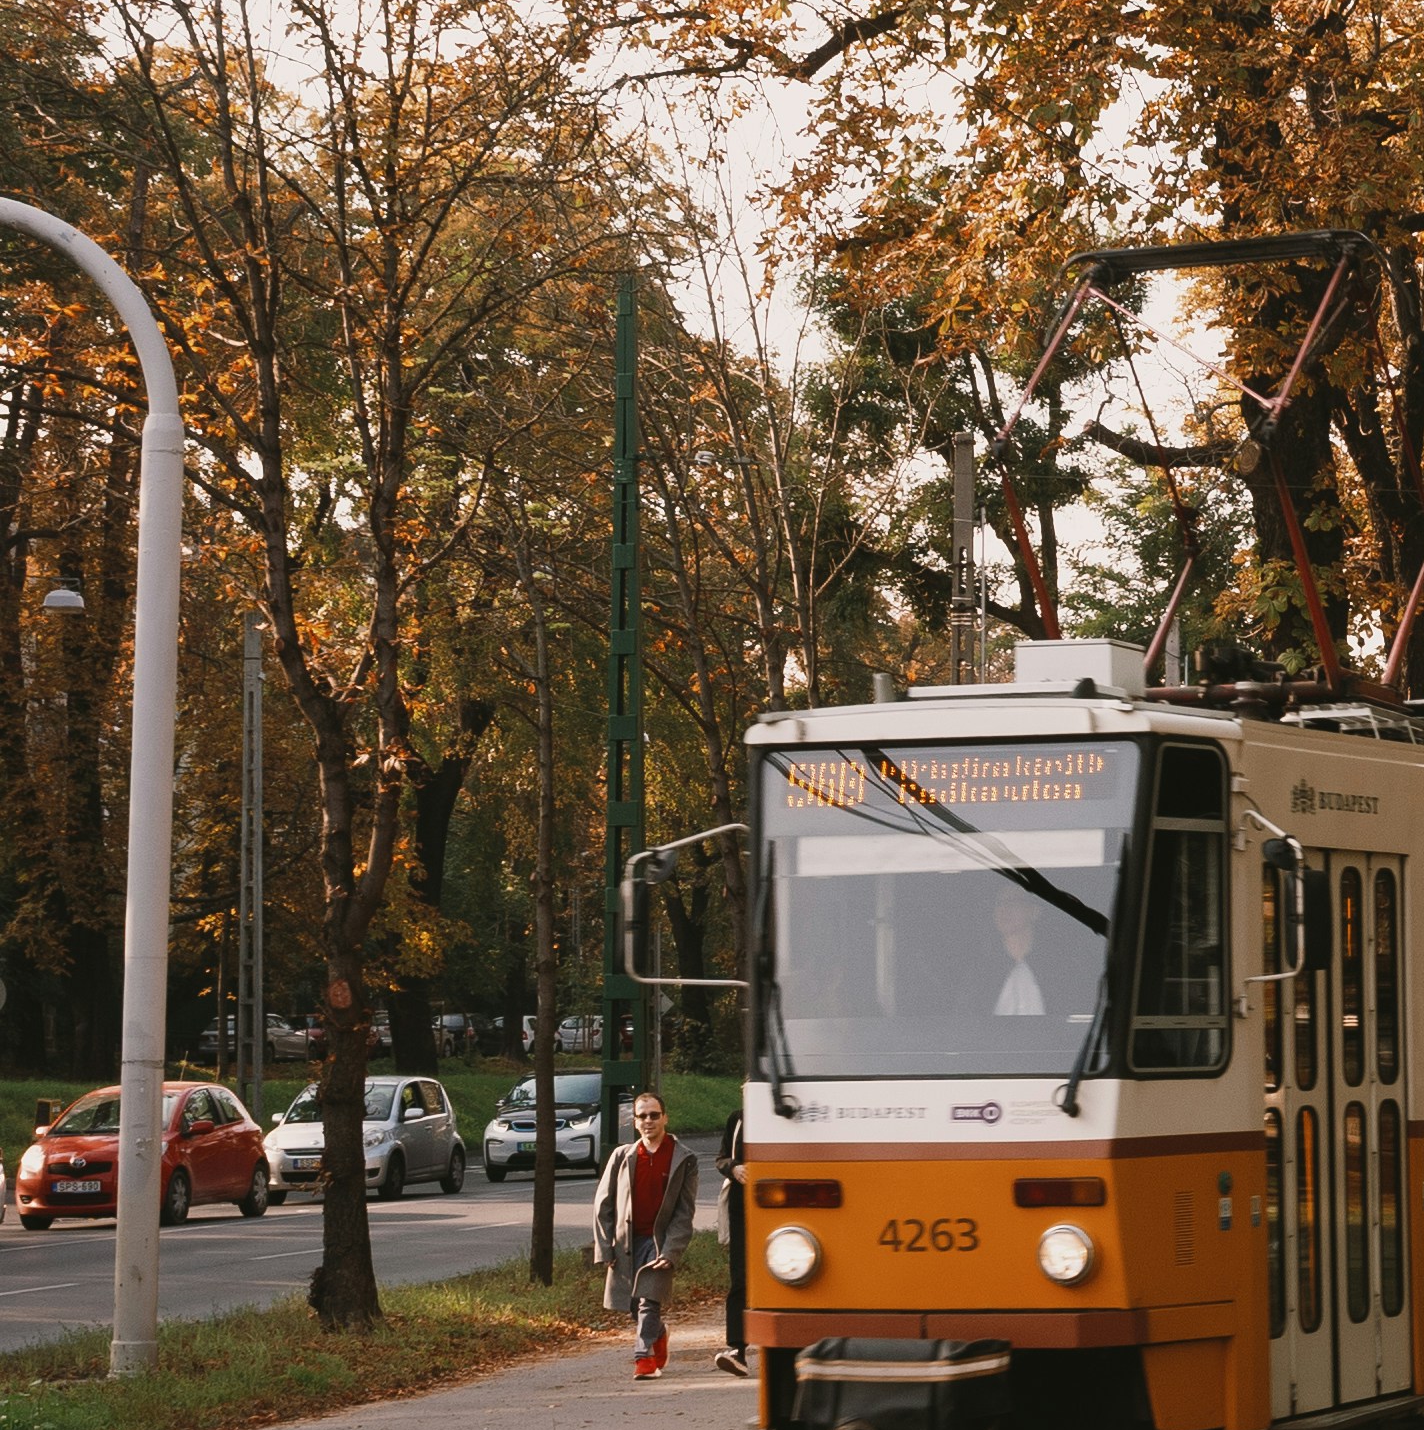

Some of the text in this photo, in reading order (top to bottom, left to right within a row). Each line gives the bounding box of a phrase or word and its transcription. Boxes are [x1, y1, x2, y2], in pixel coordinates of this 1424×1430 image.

[1319, 791, 1379, 814] BUDAPEST
[836, 1107, 927, 1120] BUDAPEST
[878, 1217, 980, 1253] 4263
